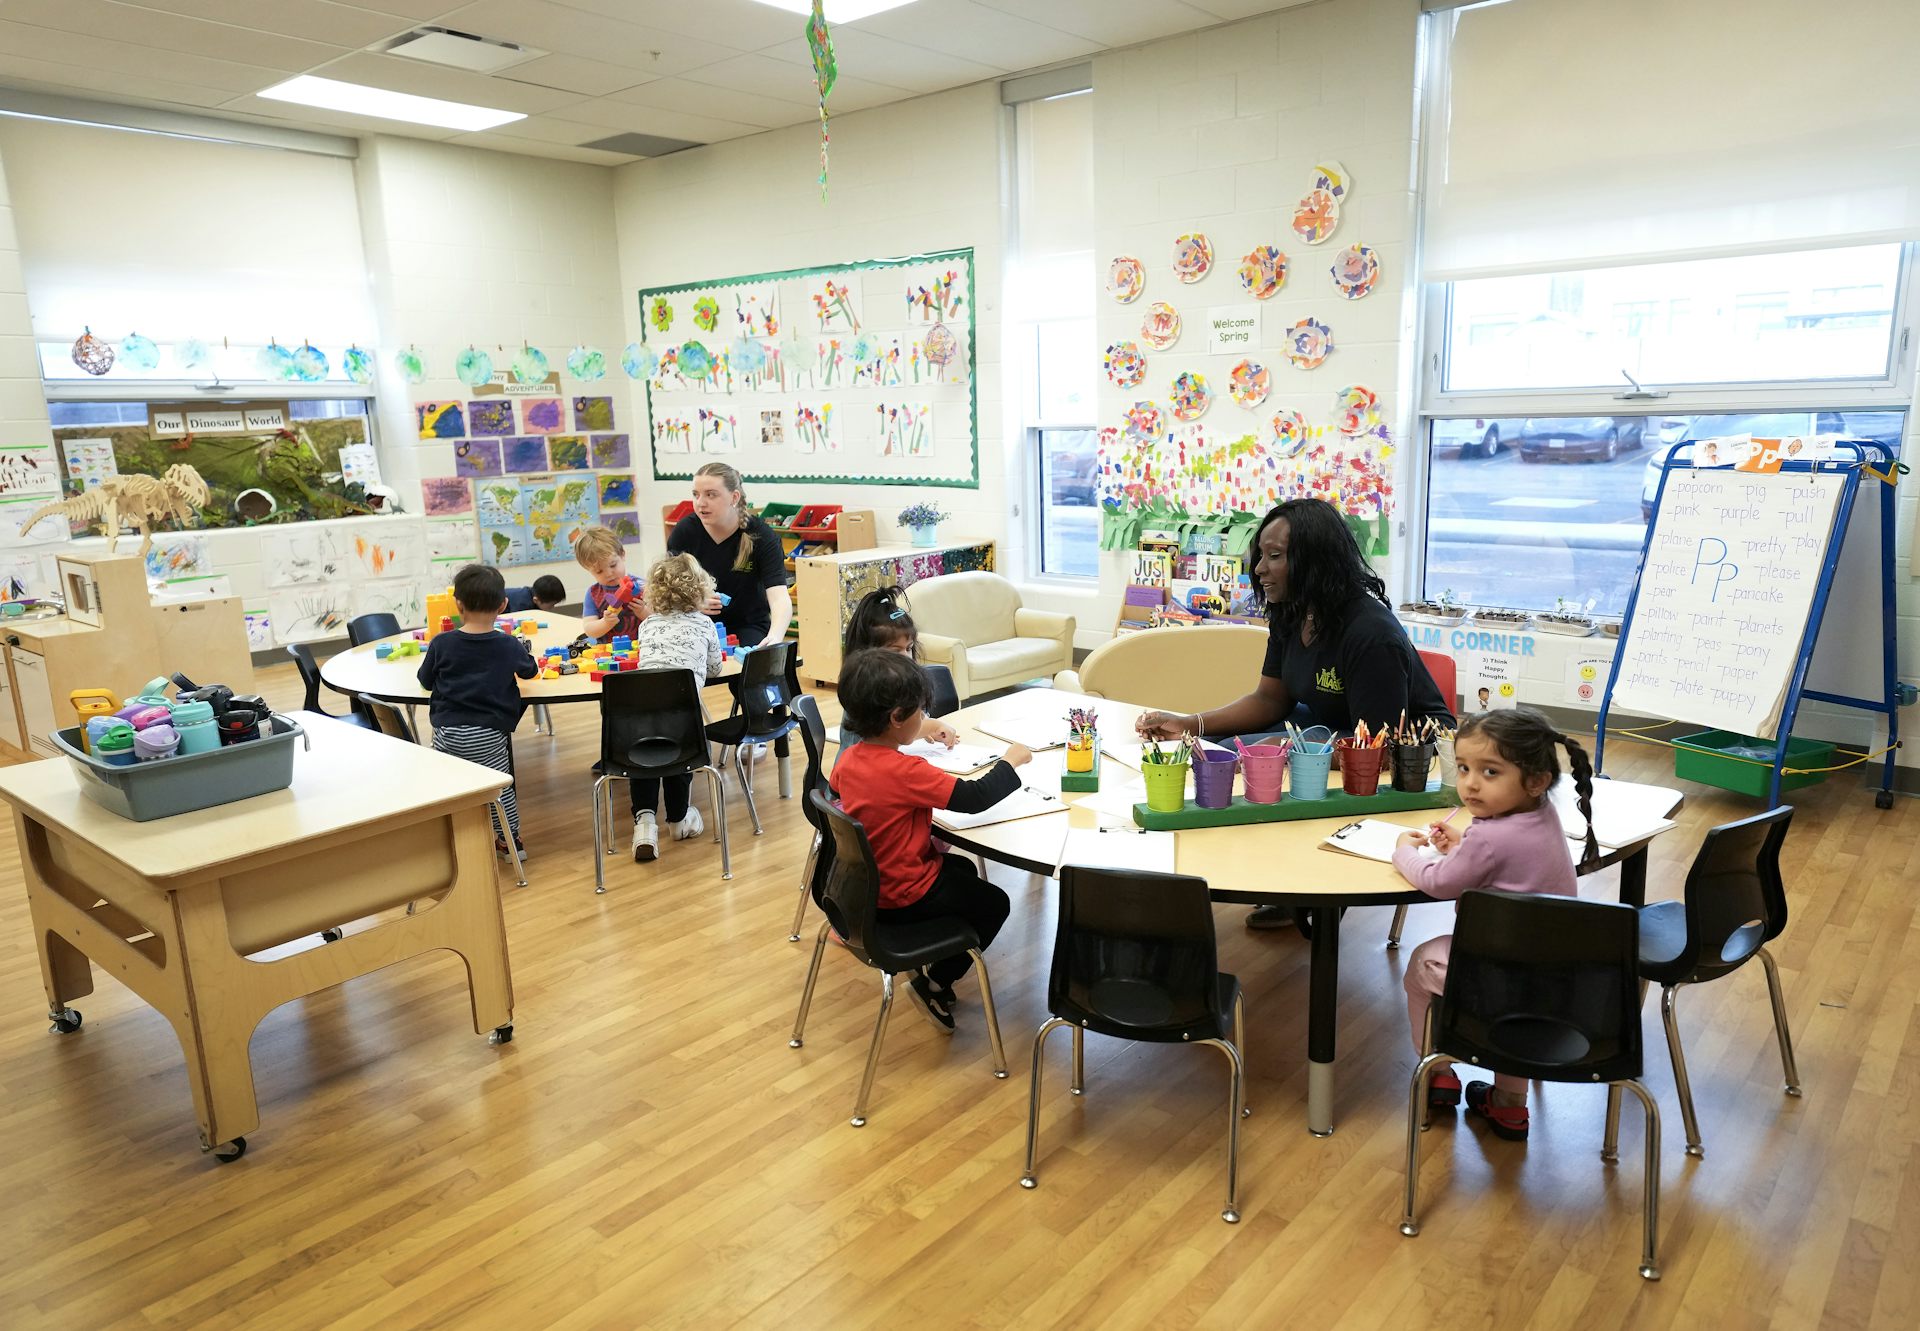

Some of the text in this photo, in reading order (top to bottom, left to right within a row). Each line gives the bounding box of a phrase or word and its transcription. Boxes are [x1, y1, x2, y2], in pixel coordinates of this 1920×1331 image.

[1213, 319, 1254, 329] Welcome
[1220, 332, 1249, 343] Spring
[157, 416, 282, 430] Our Dinosaur World
[1194, 543, 1213, 553] DRUM
[1135, 553, 1166, 578] JUST
[1201, 558, 1237, 584] JUST
[1403, 625, 1536, 657] LM CORNER
[1484, 665, 1504, 673] Happy
[1479, 672, 1508, 680] Thoughts
